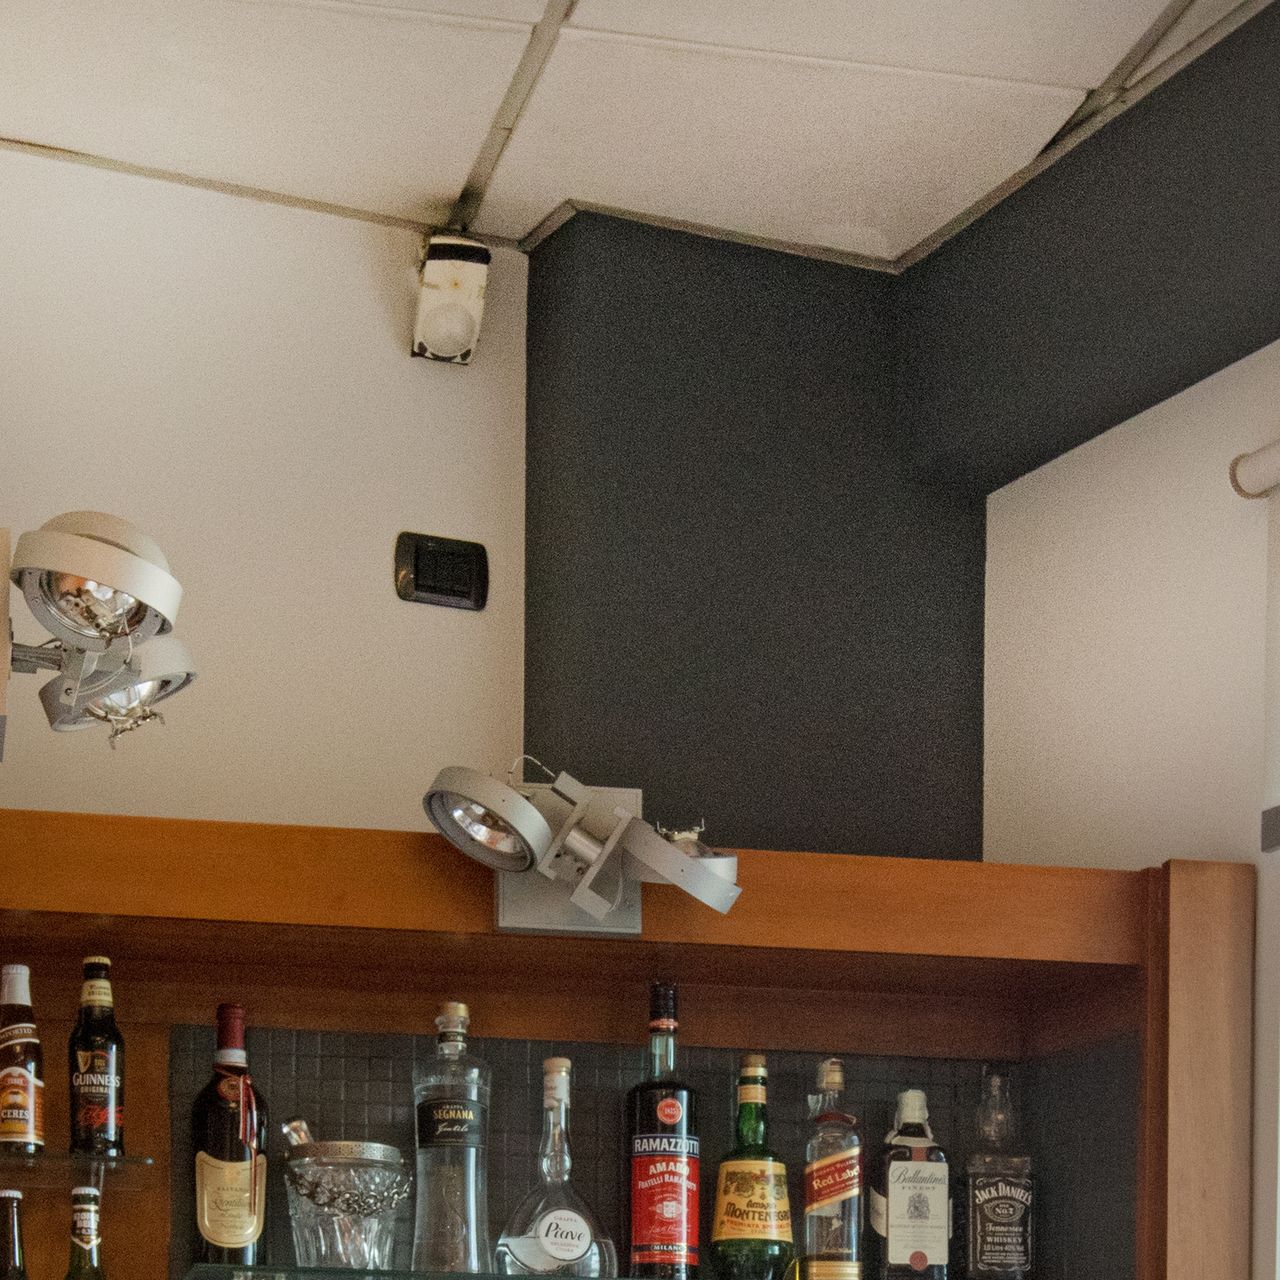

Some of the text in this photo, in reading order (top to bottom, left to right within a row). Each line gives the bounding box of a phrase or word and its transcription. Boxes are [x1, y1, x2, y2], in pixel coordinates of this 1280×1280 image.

[73, 1072, 121, 1087] GUINNESS
[1, 1109, 30, 1120] CERES
[433, 1109, 474, 1120] SEGNANA
[634, 1138, 700, 1155] RAMAZZOTTI
[812, 1175, 834, 1190] Red
[836, 1165, 861, 1183] Label
[975, 1186, 999, 1204] JACK
[545, 1222, 586, 1241] Piave
